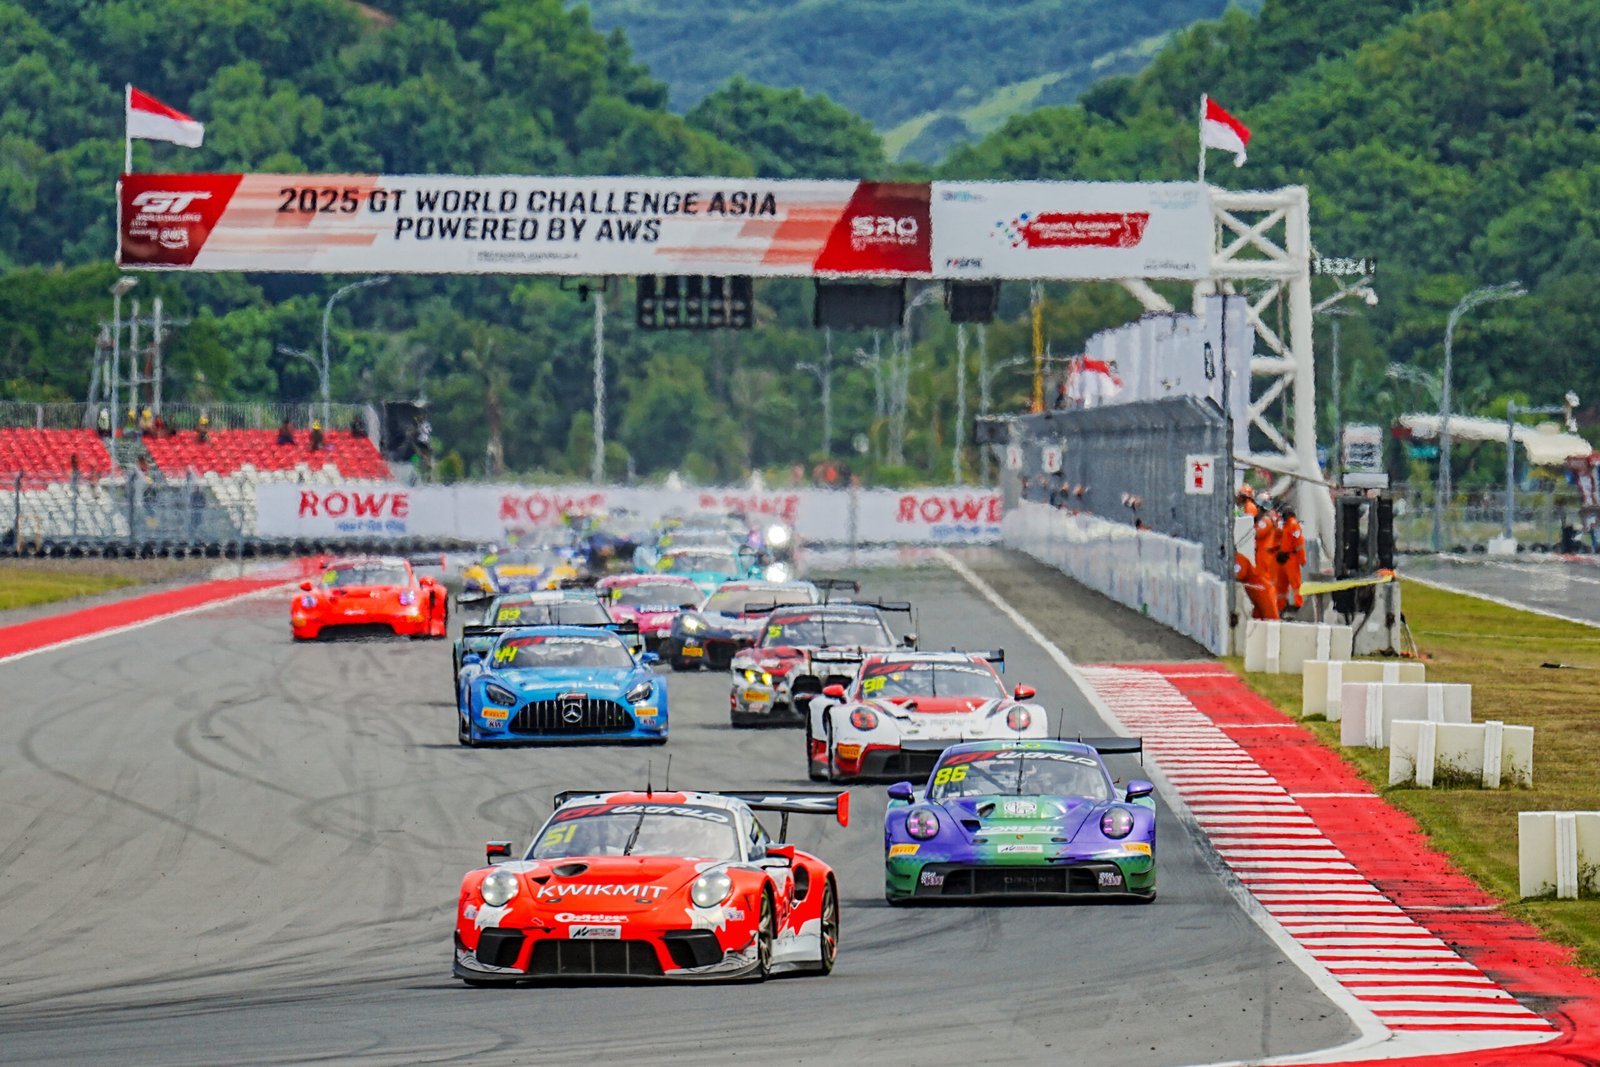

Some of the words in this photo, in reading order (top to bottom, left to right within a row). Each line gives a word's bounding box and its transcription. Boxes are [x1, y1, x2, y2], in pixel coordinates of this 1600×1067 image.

[131, 190, 213, 213] GT
[278, 187, 359, 213] 2025
[368, 188, 408, 213] GT
[415, 190, 518, 214] WORLD
[526, 190, 700, 216] CHALLENGE
[706, 191, 778, 217] ASIA
[394, 216, 538, 241] POWERED
[547, 217, 588, 242] BY
[595, 218, 662, 243] AWS
[299, 489, 410, 518] ROWE
[494, 645, 518, 662] 44
[943, 750, 1013, 766] GT
[995, 752, 1098, 767] WORLD
[934, 765, 969, 785] 86
[551, 805, 617, 821] GT
[610, 805, 730, 823] WORLD
[543, 825, 577, 846] 51
[536, 884, 669, 899] KWIKMIT
